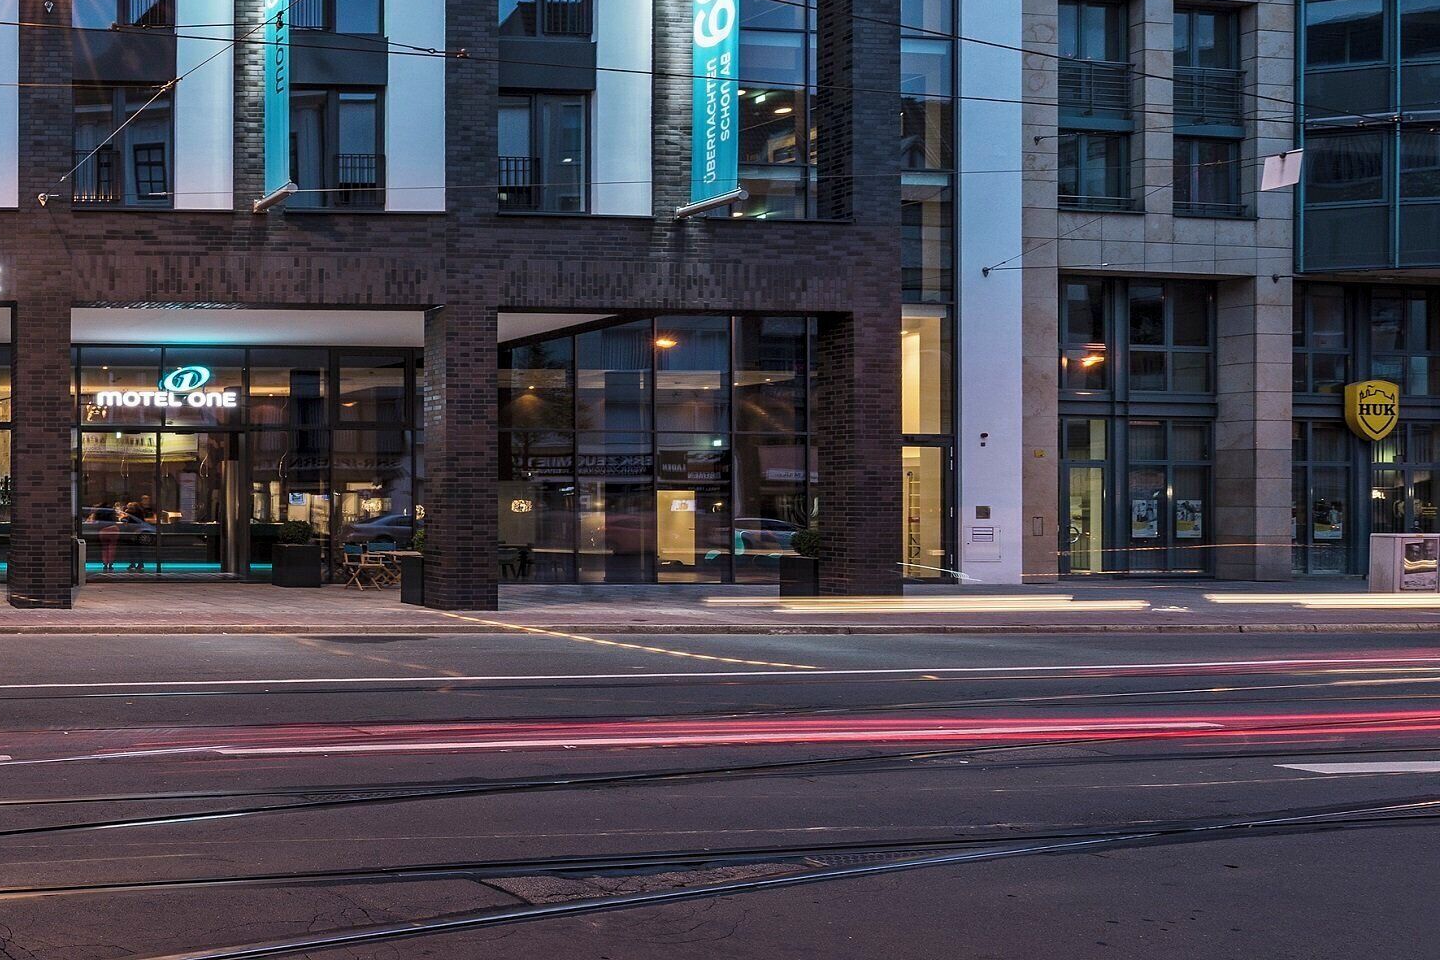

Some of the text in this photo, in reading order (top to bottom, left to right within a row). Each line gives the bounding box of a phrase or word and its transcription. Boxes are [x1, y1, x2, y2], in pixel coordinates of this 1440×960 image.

[703, 57, 718, 184] ÜBERNACHTEN
[720, 52, 731, 141] SCHON AB
[97, 391, 237, 407] MOTEL ONE
[1358, 403, 1396, 416] HUK
